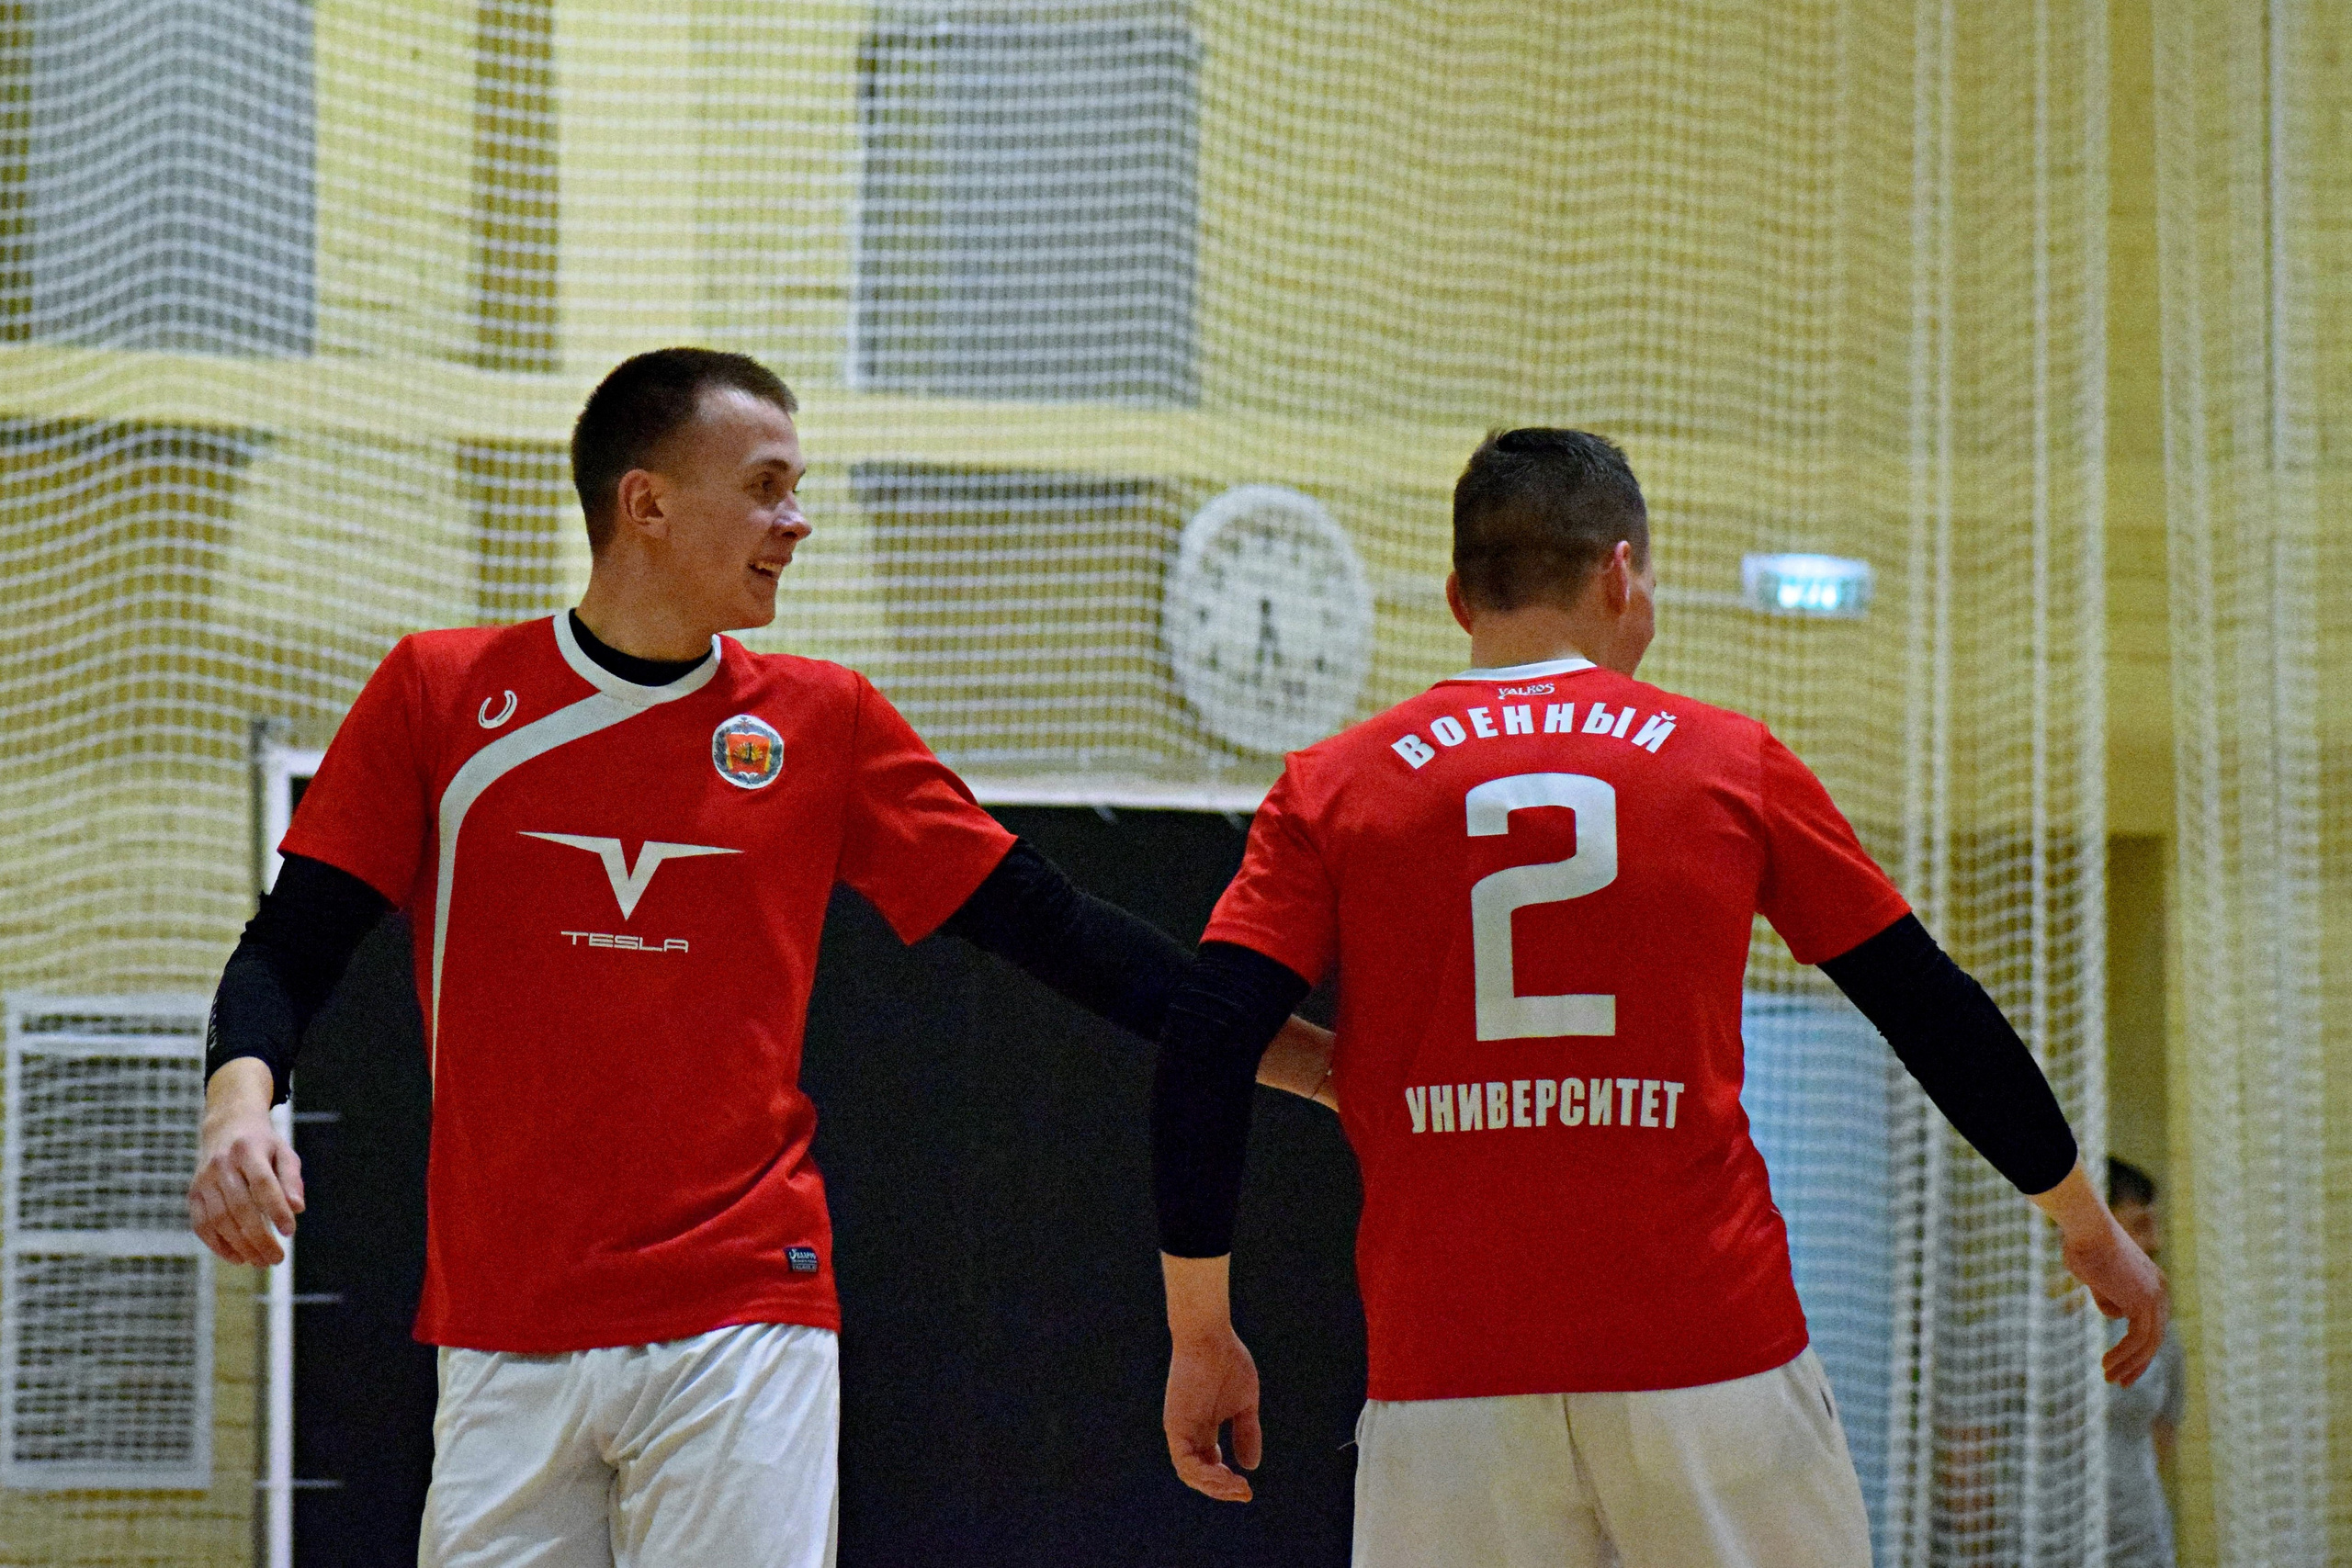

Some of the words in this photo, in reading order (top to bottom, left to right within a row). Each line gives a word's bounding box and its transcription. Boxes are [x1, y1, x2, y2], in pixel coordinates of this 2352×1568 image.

[1391, 703, 1678, 770] ВОЕННЫЙ
[1465, 772, 1618, 1042] 2
[560, 931, 689, 953] TESLA
[1405, 1077, 1685, 1134] УНИВЕРСИТЕТ
